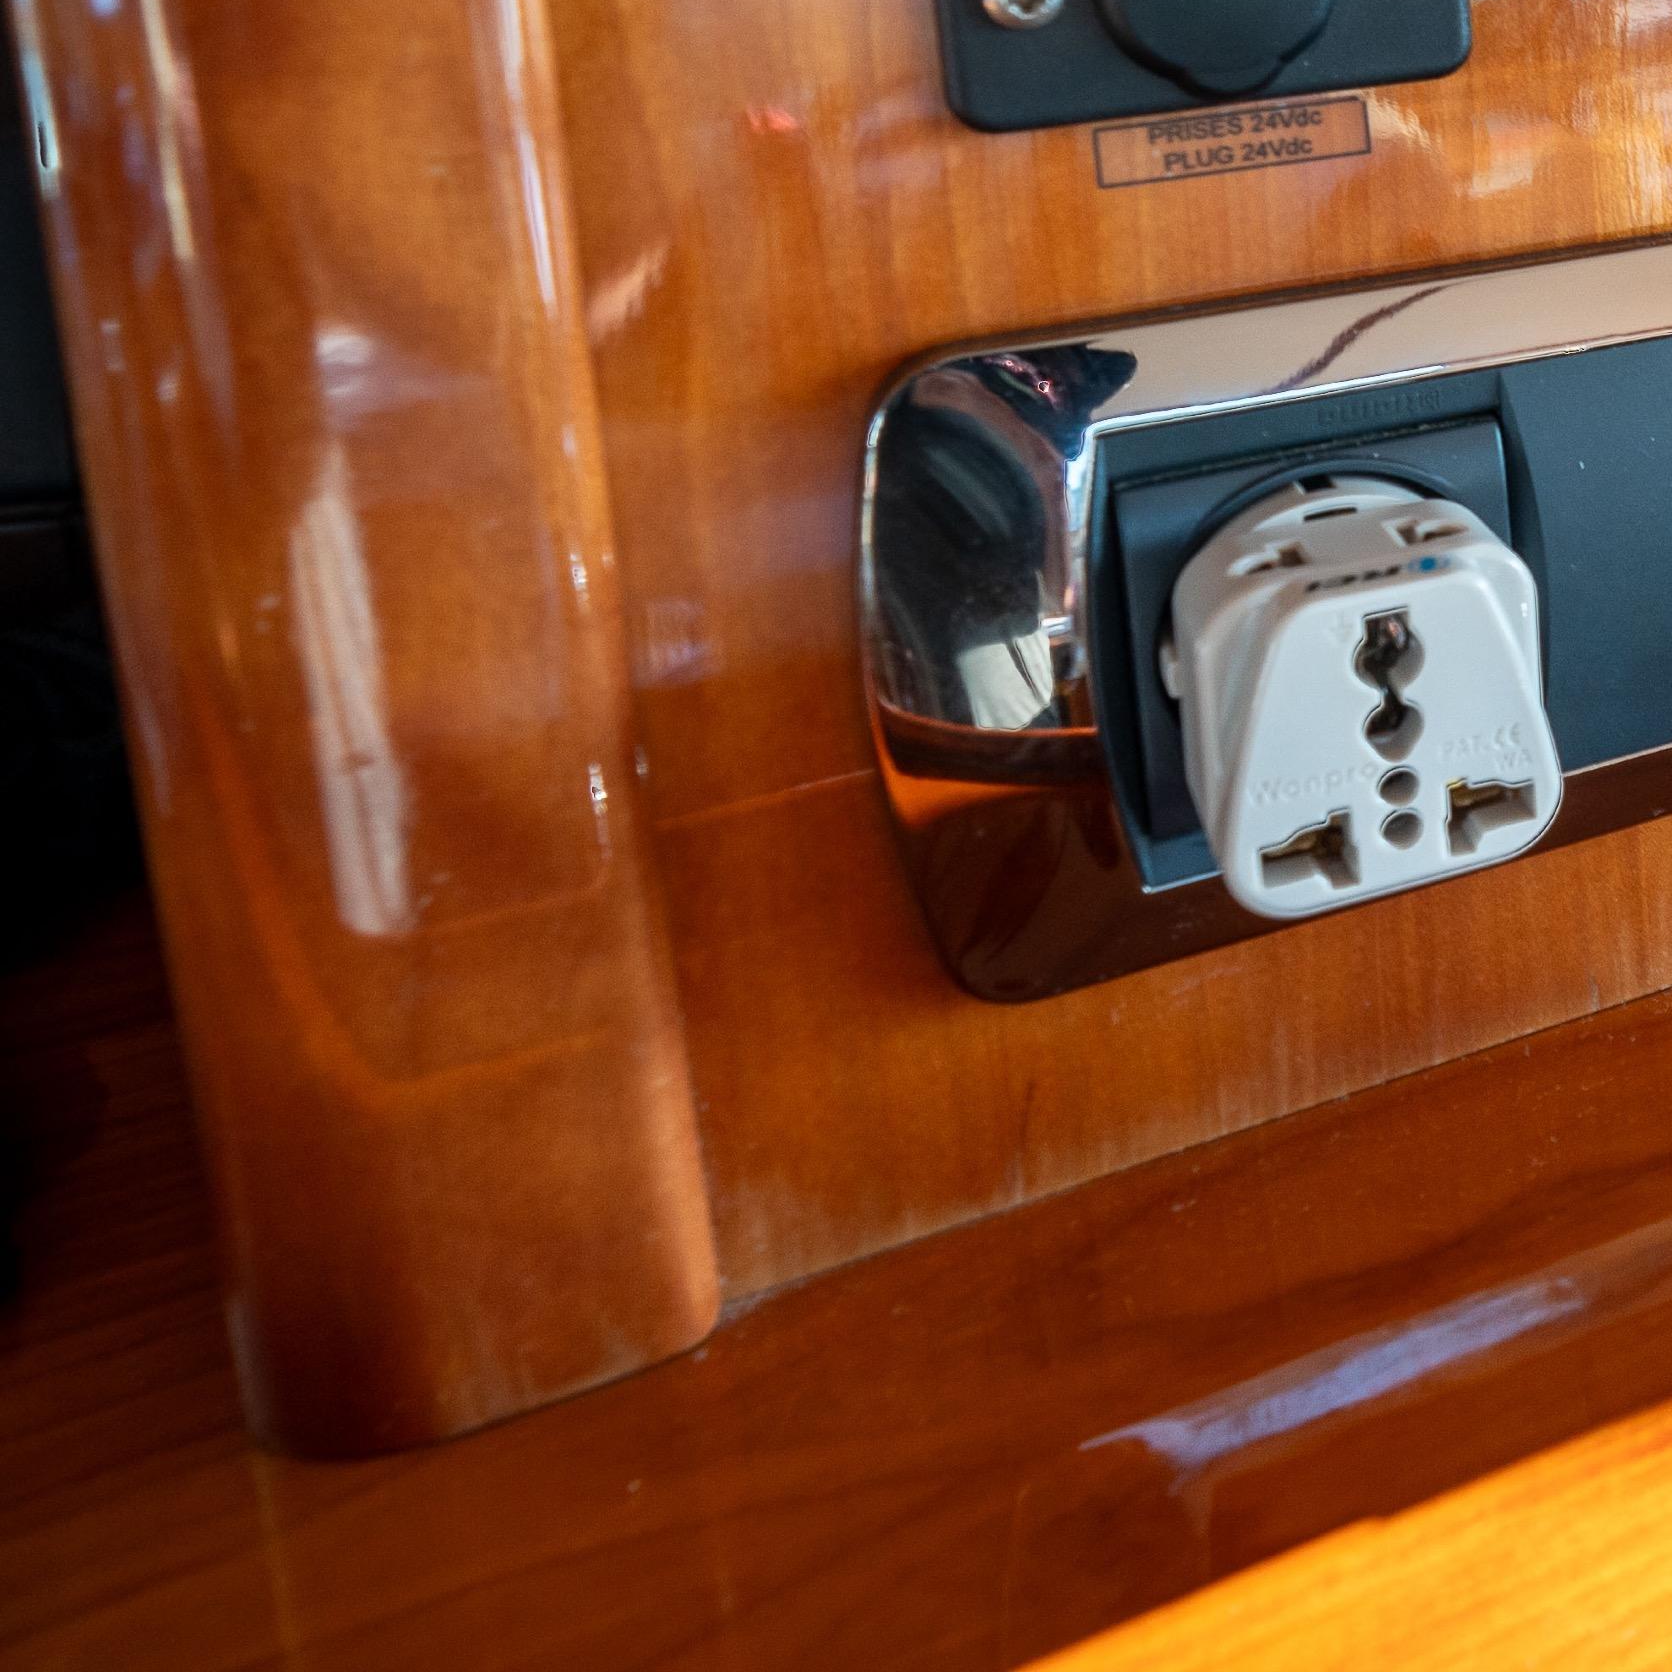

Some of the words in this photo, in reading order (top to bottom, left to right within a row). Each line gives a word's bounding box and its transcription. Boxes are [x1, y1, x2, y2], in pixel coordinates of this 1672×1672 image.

[1147, 114, 1243, 144] PRISES
[1250, 108, 1323, 133] 24Vdc
[1164, 145, 1234, 171] PLUG
[1241, 136, 1313, 163] 24Vdc
[1247, 761, 1379, 803] Wonpro
